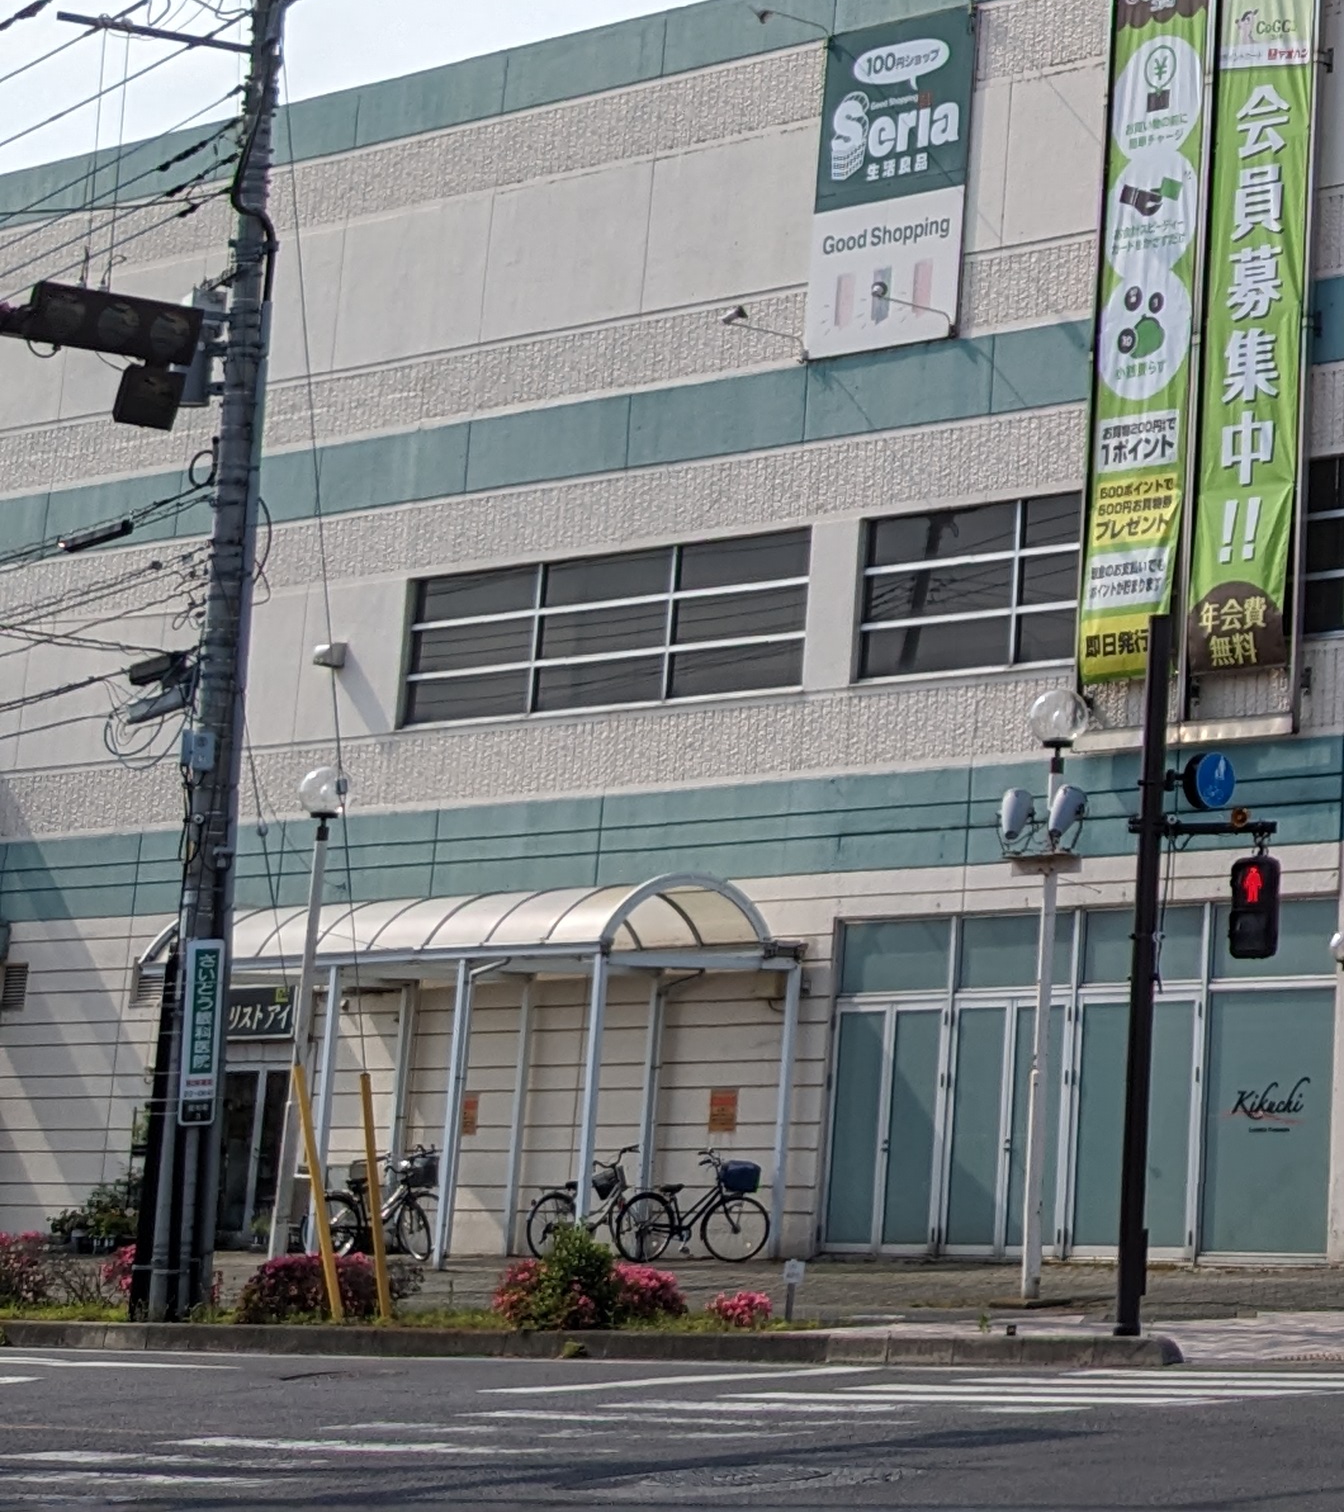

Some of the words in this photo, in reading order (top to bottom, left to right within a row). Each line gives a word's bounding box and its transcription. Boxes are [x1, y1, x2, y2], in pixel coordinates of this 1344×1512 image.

[866, 47, 941, 76] 100円ショップ
[831, 91, 961, 160] Seria
[866, 152, 929, 182] 生活良品
[822, 228, 868, 255] Good
[870, 216, 951, 247] Shopping
[1101, 434, 1175, 466] 1ポイント
[1095, 513, 1170, 541] プレゼント
[1199, 595, 1268, 633] 年会費
[1085, 629, 1150, 658] 即日発行
[1209, 631, 1257, 667] 無料
[1231, 1076, 1311, 1120] Kikuchi
